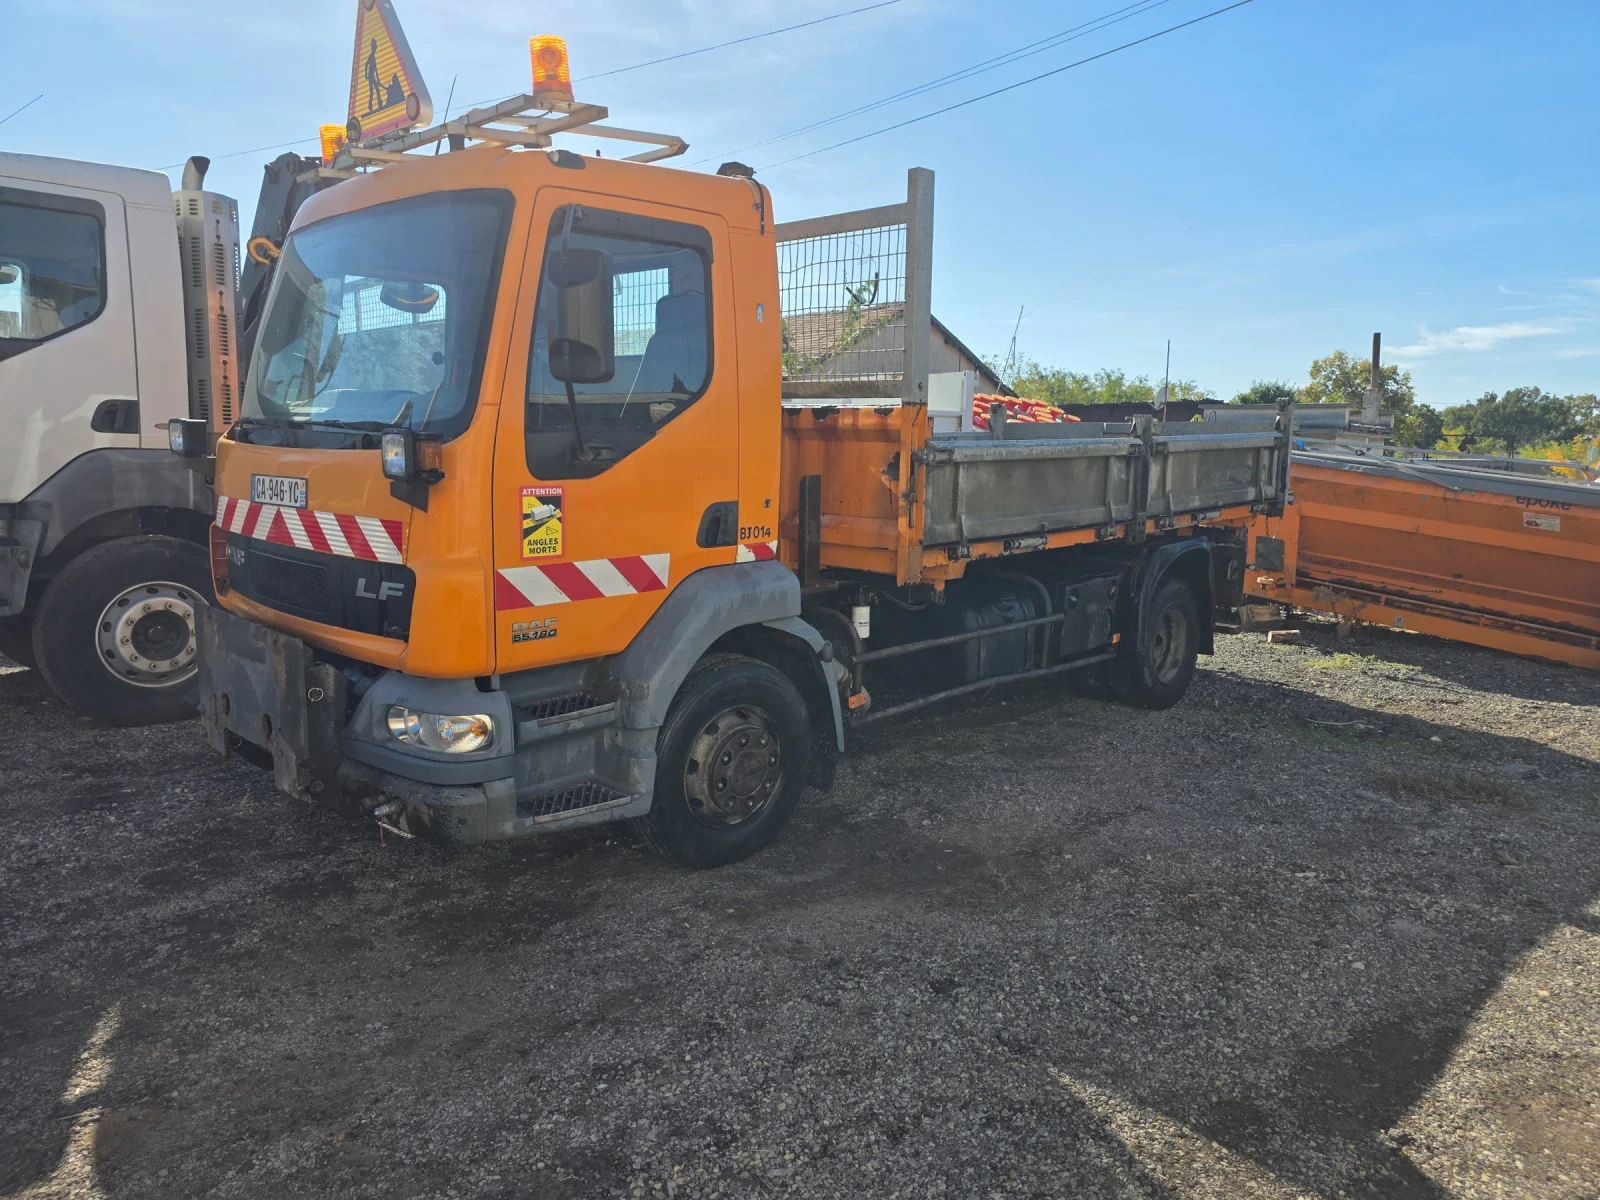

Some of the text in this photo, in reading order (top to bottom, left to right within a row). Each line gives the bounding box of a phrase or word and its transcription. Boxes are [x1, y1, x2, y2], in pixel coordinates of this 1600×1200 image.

[256, 477, 299, 504] CA-946-YC
[1515, 495, 1572, 510] epoke
[527, 538, 559, 547] ANGLES
[528, 546, 557, 554] MORTS
[356, 577, 404, 600] LF
[512, 617, 558, 632] DAF
[513, 629, 557, 642] 55.180
